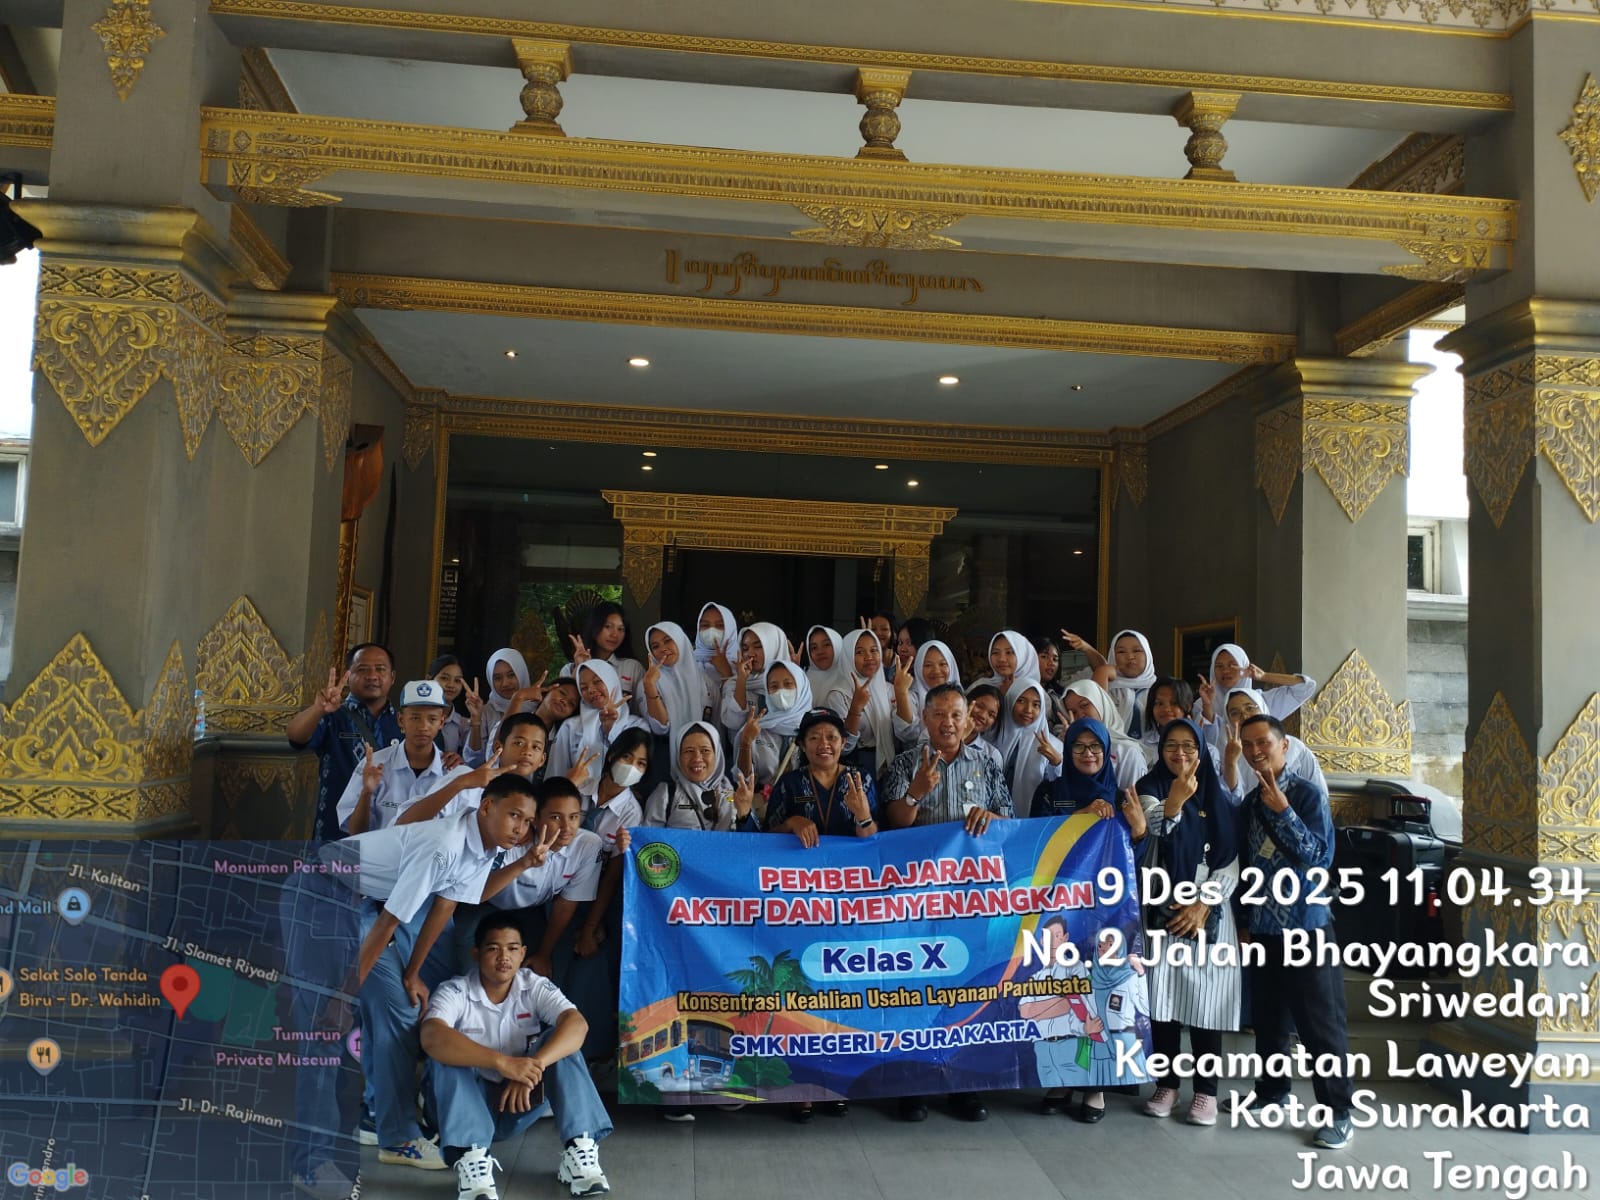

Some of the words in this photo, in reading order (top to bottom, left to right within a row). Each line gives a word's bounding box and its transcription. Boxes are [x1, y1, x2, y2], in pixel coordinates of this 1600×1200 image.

[760, 856, 1006, 892] PEMBELAJARAN
[666, 897, 763, 925] AKTIF
[764, 898, 836, 925] DAN
[839, 881, 1095, 922] MENYENANGKAN
[822, 947, 914, 975] Kelas
[919, 941, 949, 971] X
[677, 991, 781, 1012] Konsentrasi
[784, 989, 863, 1012] Keahlian
[866, 986, 922, 1009] Usaha
[925, 983, 999, 1008] Layanan
[1001, 975, 1093, 999] Pariwisata
[730, 1034, 787, 1056] SMK
[788, 1032, 876, 1055] NEGERI
[879, 1032, 897, 1053] 7
[899, 1020, 1042, 1051] SURAKARTA
